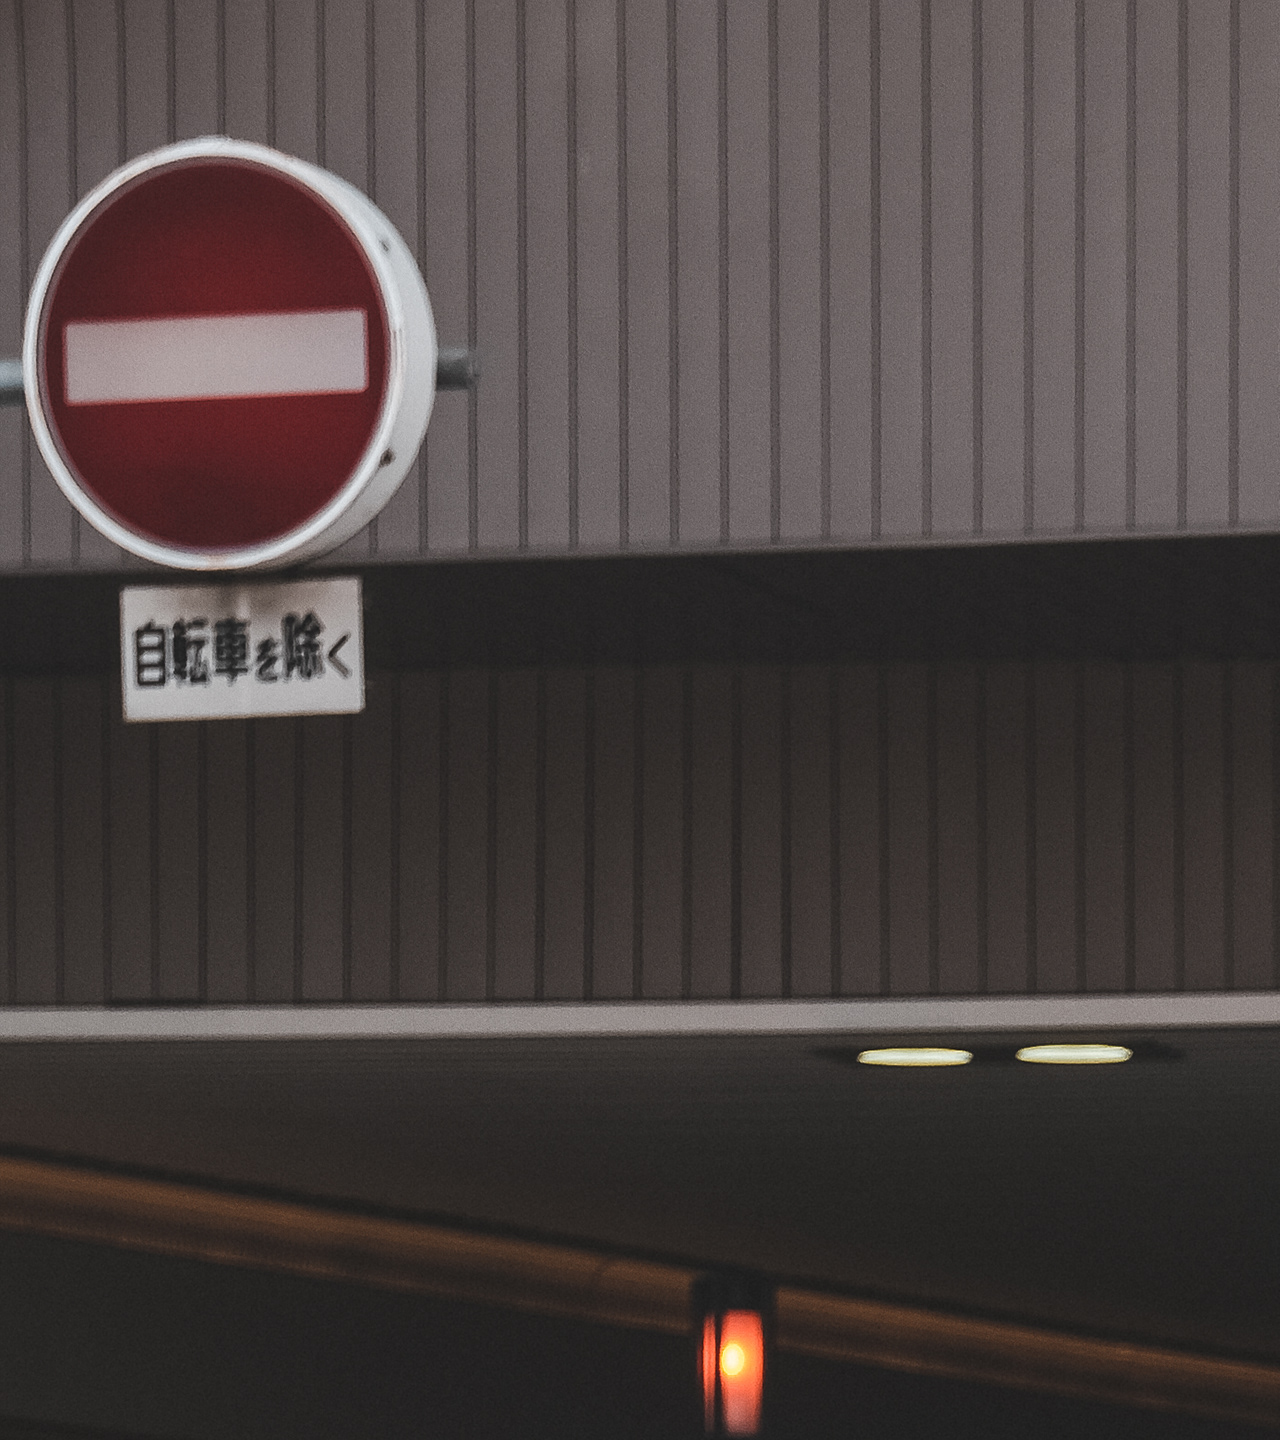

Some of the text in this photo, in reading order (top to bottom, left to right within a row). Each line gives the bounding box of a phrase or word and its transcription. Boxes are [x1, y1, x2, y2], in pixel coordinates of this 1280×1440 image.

[135, 612, 352, 686] 自転車を除く
